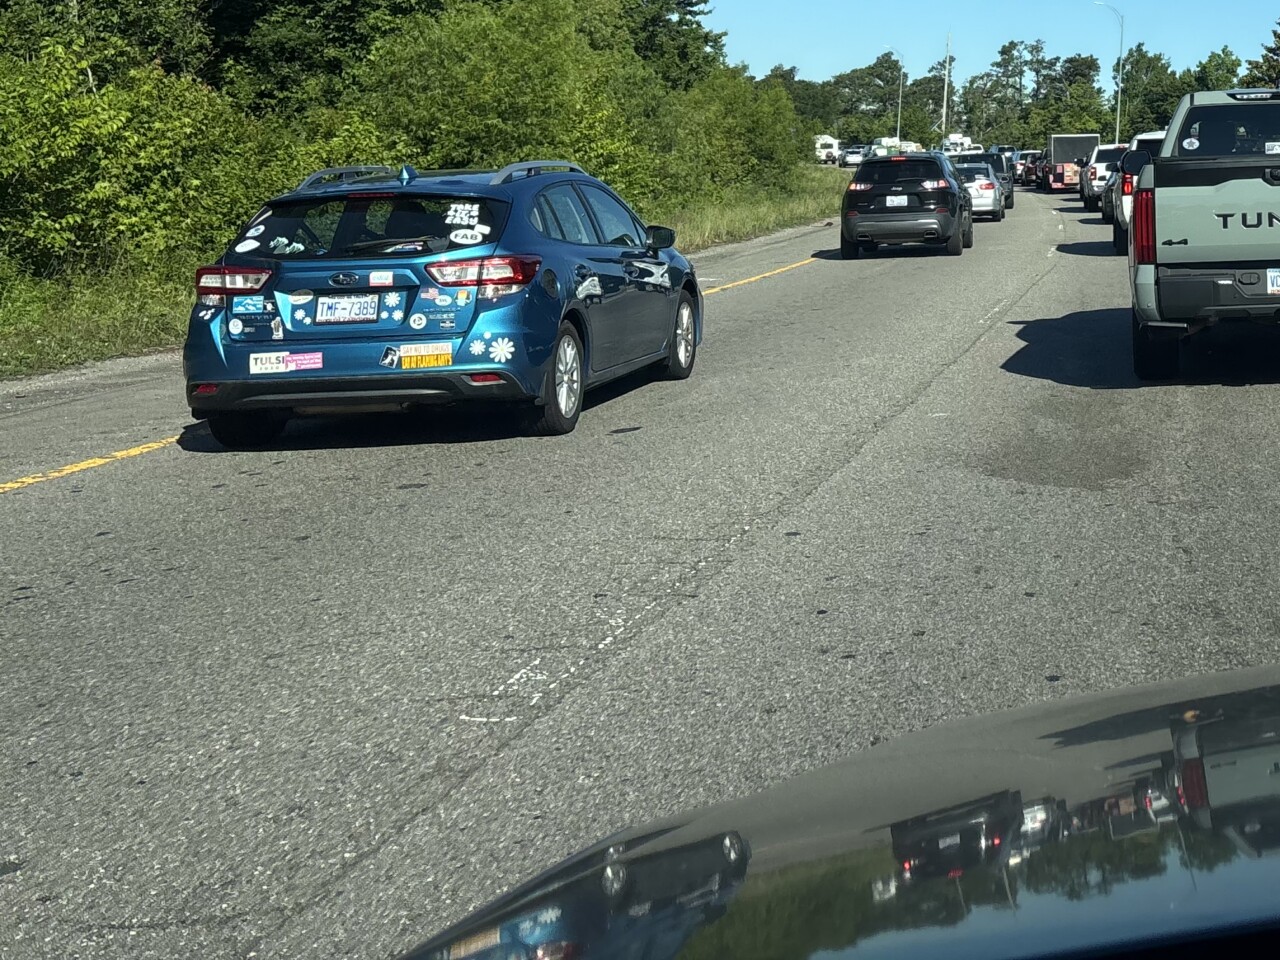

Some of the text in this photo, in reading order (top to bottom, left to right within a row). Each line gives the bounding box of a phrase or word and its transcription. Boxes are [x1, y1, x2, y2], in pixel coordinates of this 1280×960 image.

[450, 203, 480, 211] TAKE
[445, 216, 478, 225] EASY
[319, 301, 377, 317] TMF-7389
[253, 355, 285, 366] TULSI
